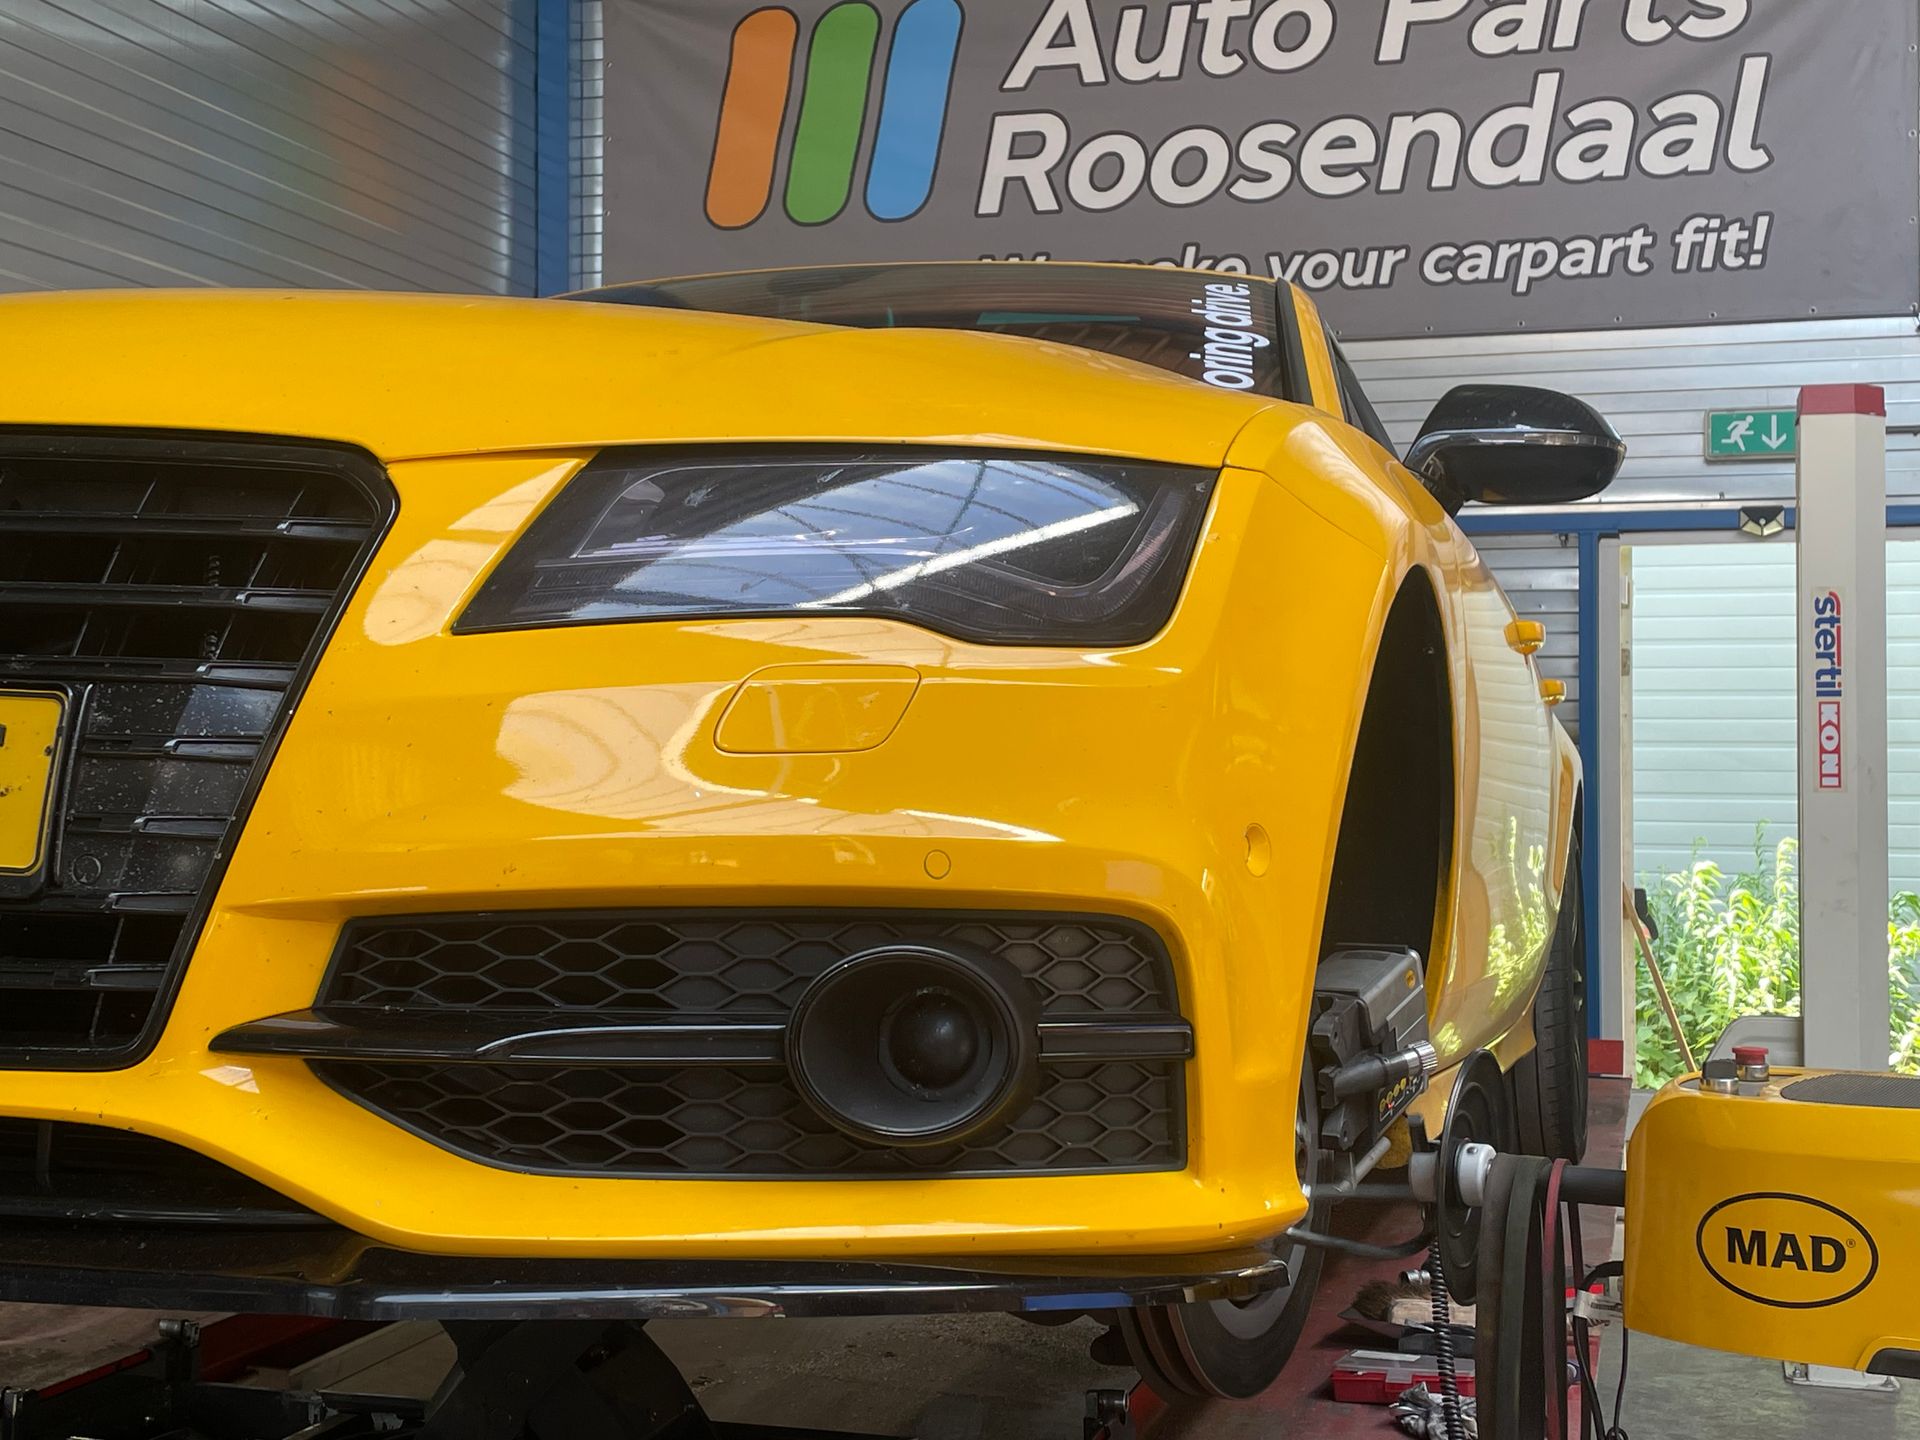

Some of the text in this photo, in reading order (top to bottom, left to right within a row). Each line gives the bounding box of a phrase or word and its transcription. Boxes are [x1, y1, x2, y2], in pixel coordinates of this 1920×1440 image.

[1001, 0, 1335, 89] Auto
[975, 56, 1770, 214] Roosendaal
[1268, 246, 1405, 289] your
[1422, 228, 1654, 292] carpart
[1673, 215, 1769, 270] fit!
[1819, 702, 1841, 787] KONI
